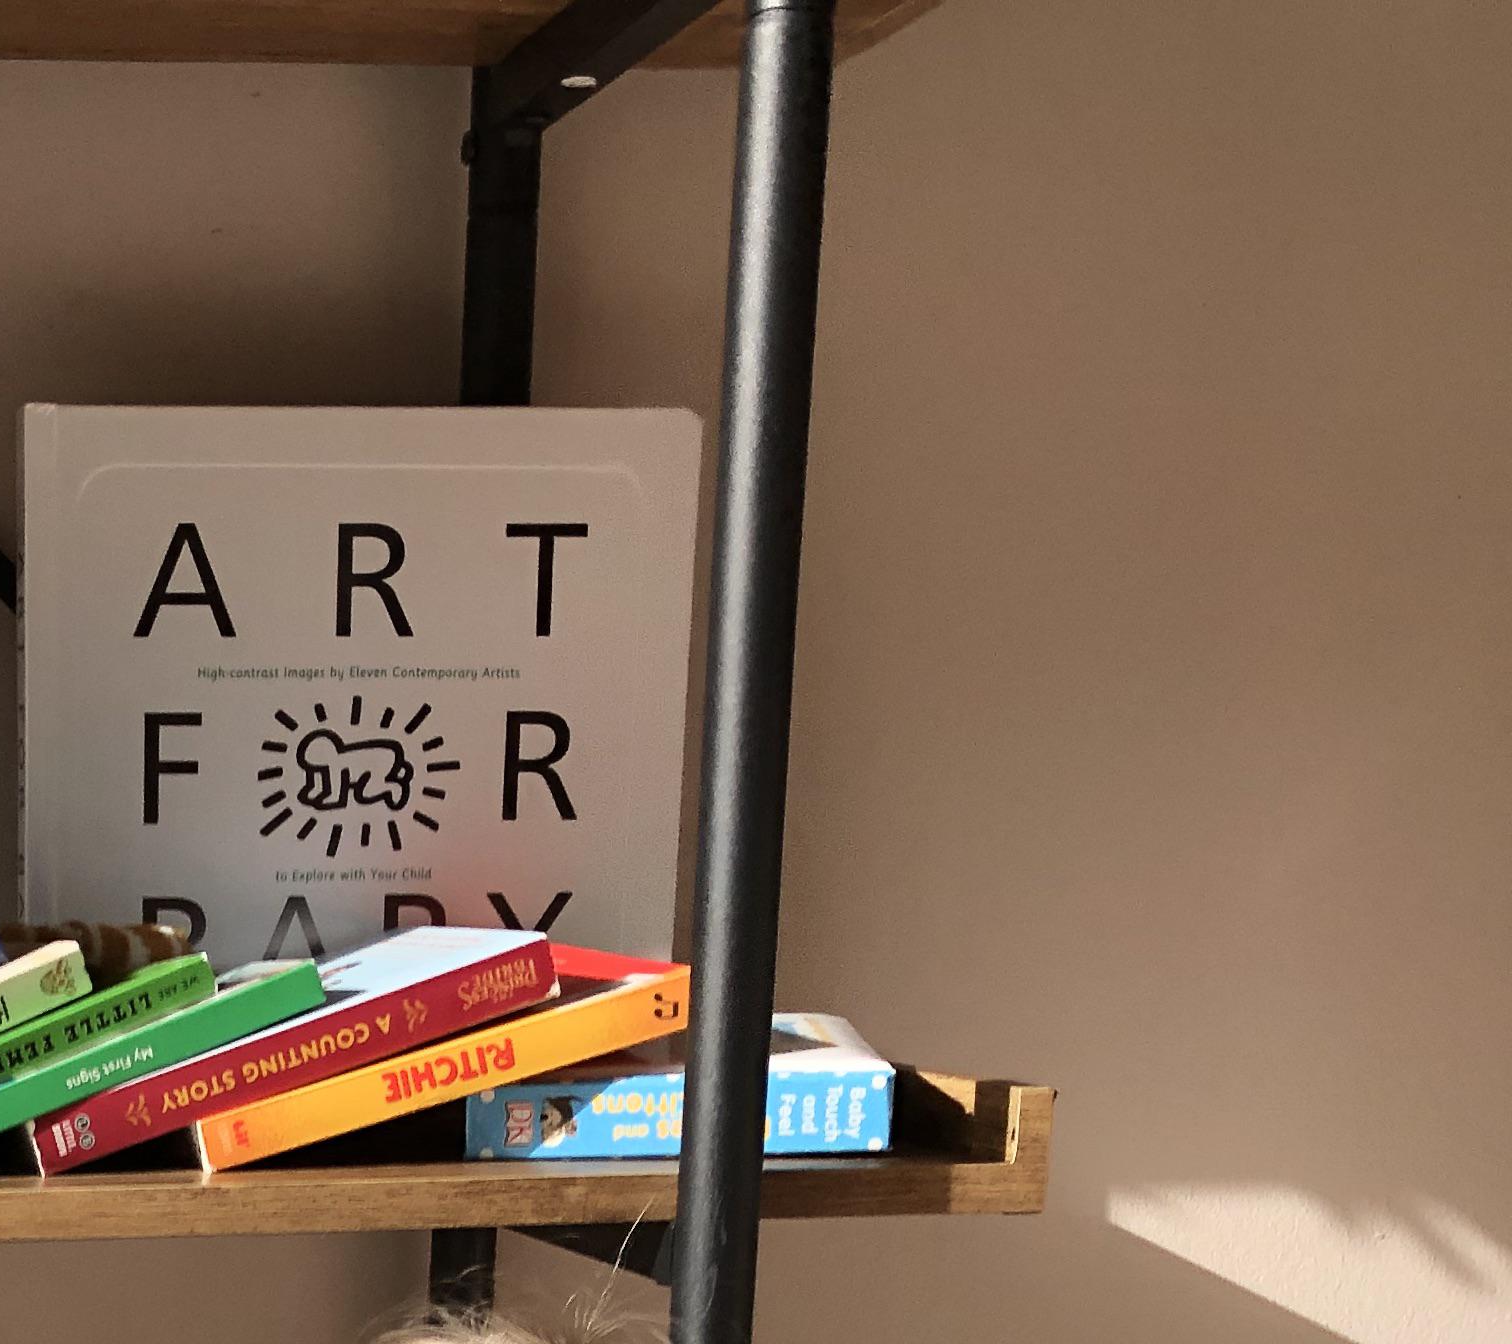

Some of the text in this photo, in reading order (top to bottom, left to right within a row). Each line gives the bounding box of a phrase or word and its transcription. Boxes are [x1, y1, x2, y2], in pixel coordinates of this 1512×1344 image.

[133, 522, 589, 638] ART
[197, 665, 521, 685] High-contrast Images by Eleven Contemporary Artists
[276, 866, 433, 886] to Explore with Your Child
[62, 1042, 155, 1092] My First Signs
[156, 1012, 393, 1115] A COUNTING STORY
[378, 1034, 517, 1108] RITCHIE
[505, 1101, 534, 1147] DK
[778, 1093, 797, 1136] Feel
[801, 1094, 816, 1135] and
[825, 1084, 844, 1142] Touch
[844, 1087, 866, 1138] Baby
